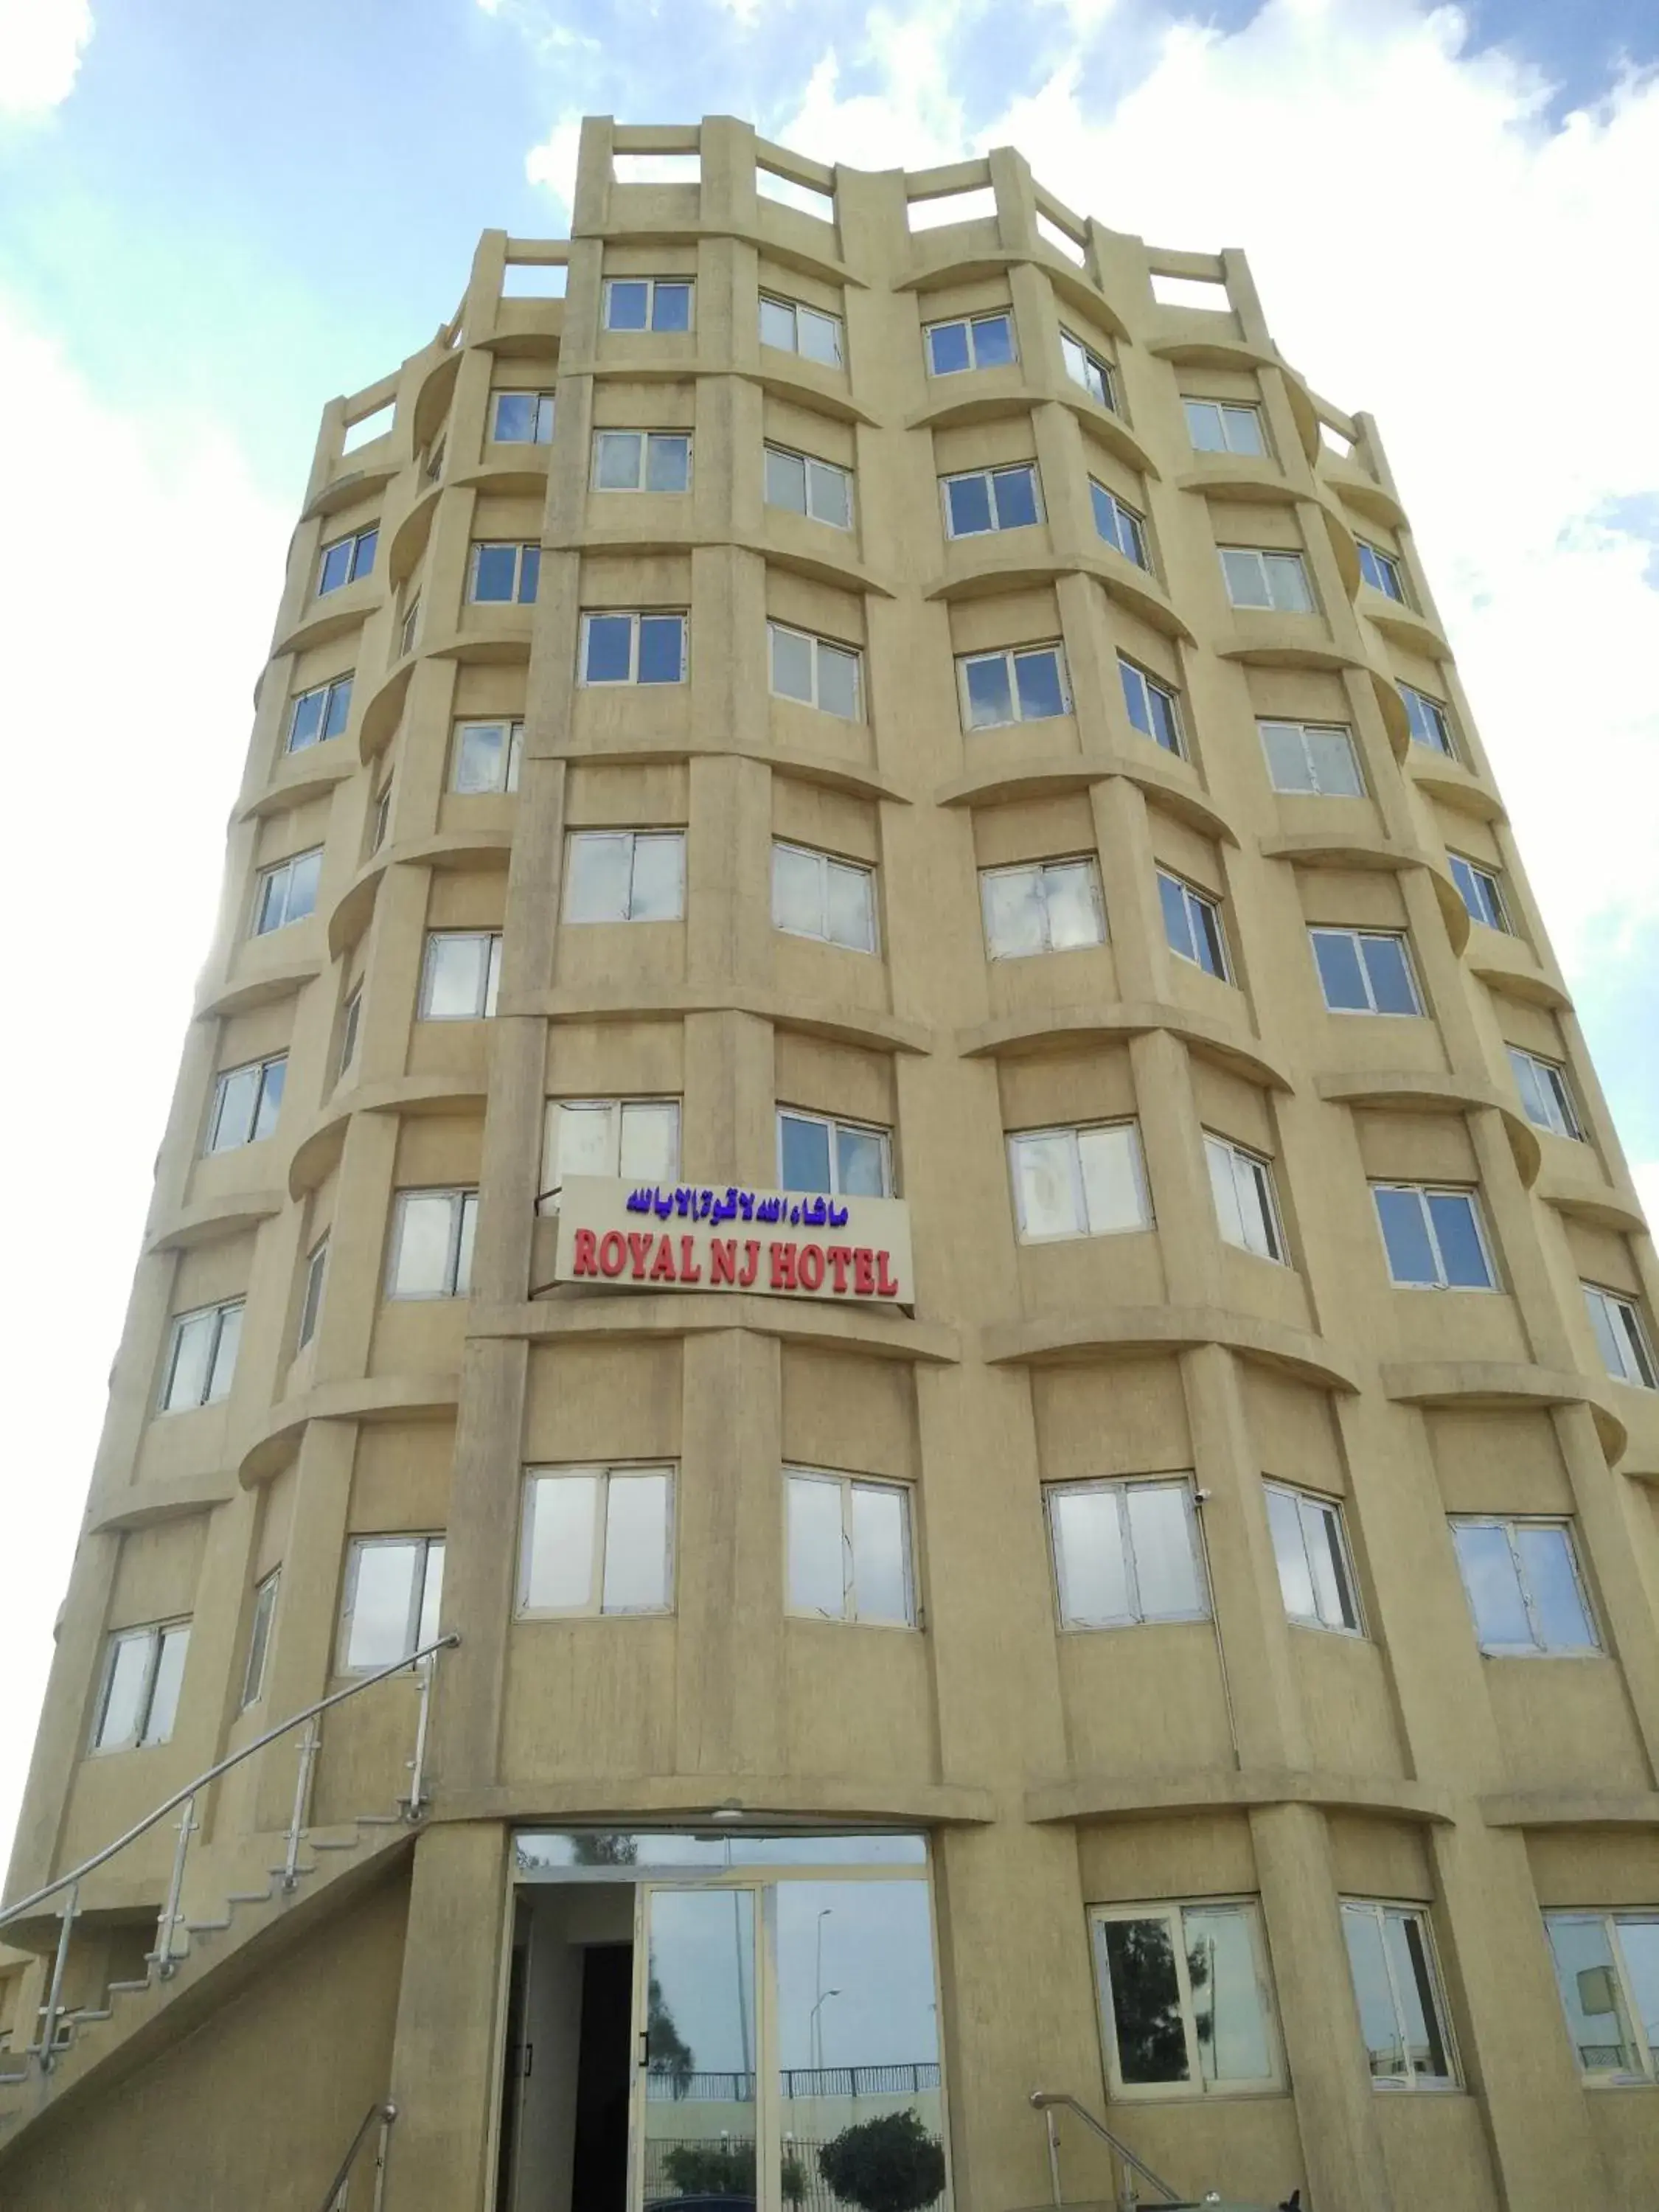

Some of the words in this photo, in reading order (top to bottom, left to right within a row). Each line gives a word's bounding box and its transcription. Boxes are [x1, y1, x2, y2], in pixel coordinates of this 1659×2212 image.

[756, 1197, 788, 1223] الله
[574, 1228, 702, 1283] ROYAL
[709, 1238, 761, 1287] NJ
[769, 1242, 900, 1296] HOTEL
